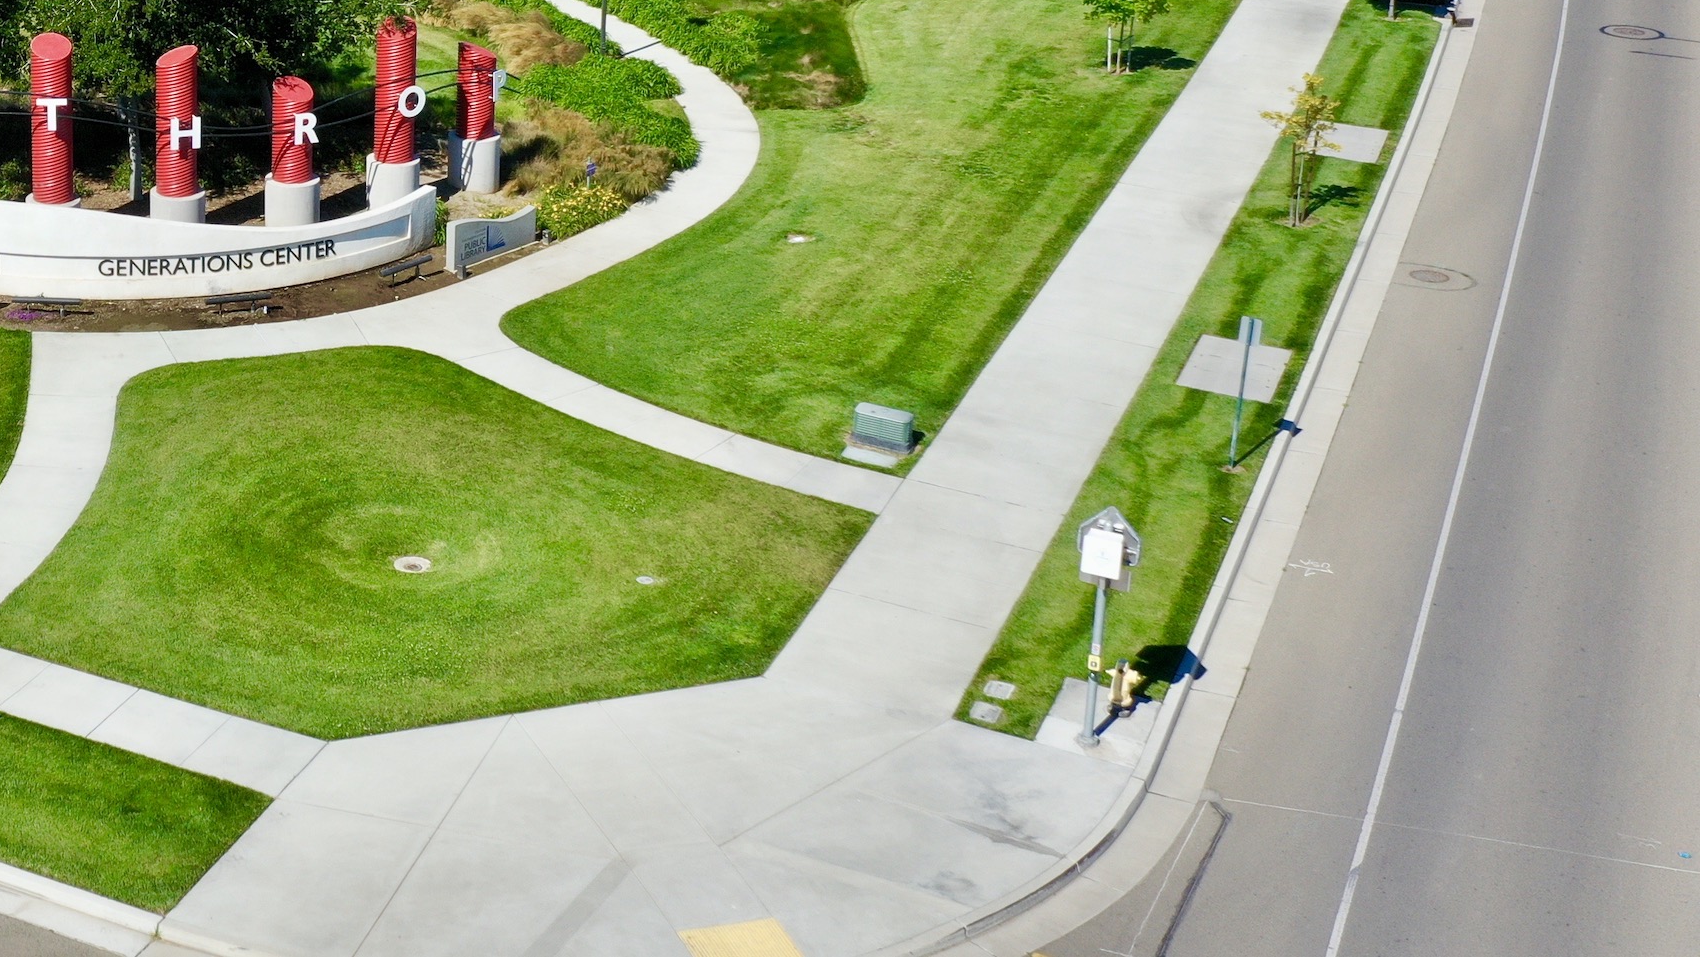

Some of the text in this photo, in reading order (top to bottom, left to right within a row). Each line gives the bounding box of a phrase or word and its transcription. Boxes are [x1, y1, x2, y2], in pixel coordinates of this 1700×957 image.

[464, 236, 486, 251] PUBLIC
[98, 239, 337, 277] GENERATIONS CENTER
[461, 245, 486, 261] LIBRARY
